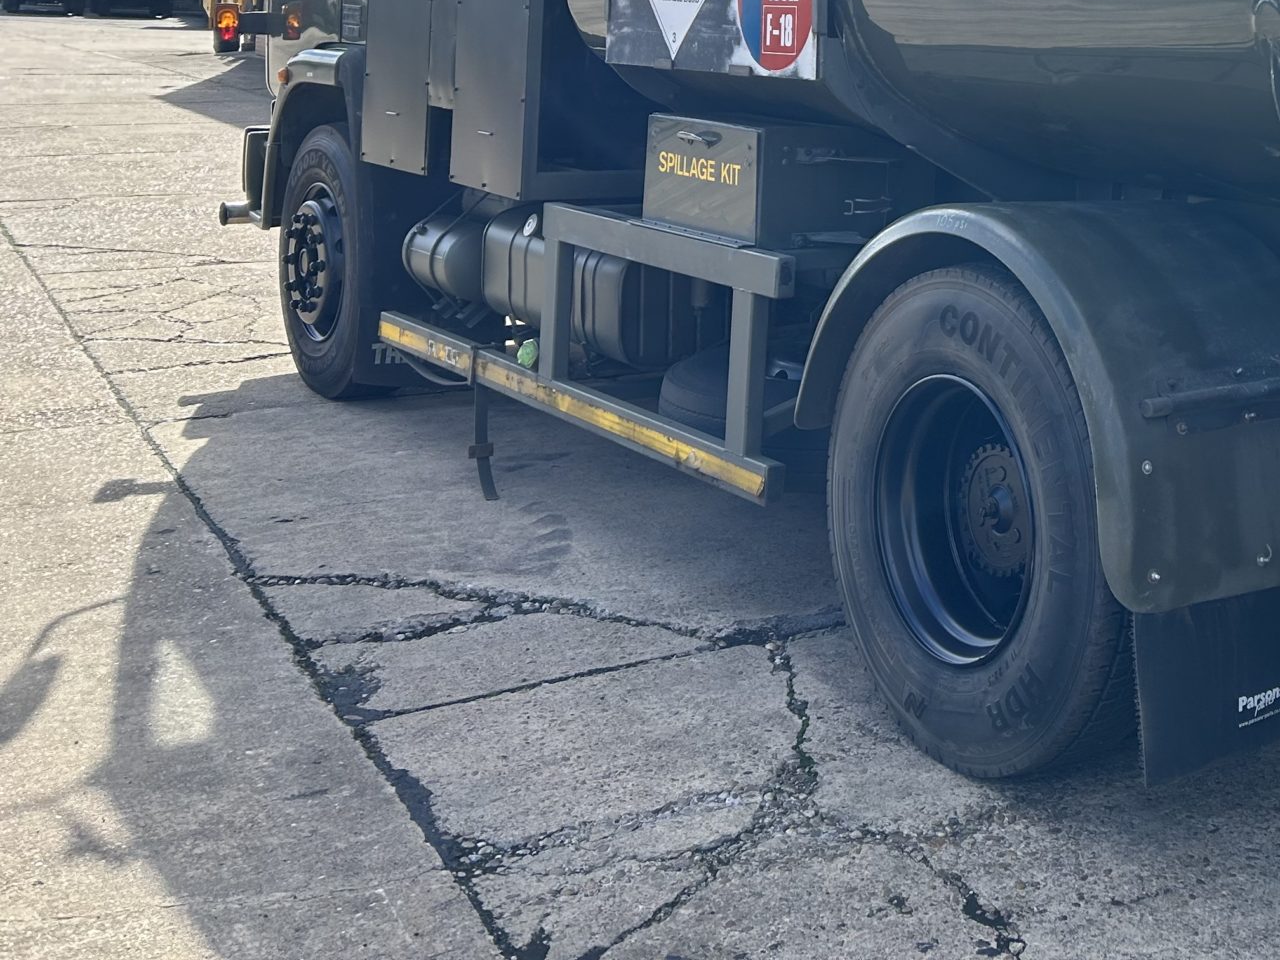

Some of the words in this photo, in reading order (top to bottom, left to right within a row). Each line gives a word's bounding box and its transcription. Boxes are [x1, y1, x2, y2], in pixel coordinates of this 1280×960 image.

[672, 31, 677, 43] 3
[766, 13, 793, 47] F-18
[658, 151, 716, 183] SPILLAGE
[720, 163, 742, 187] KIT
[938, 304, 1074, 593] CONTINENTAL
